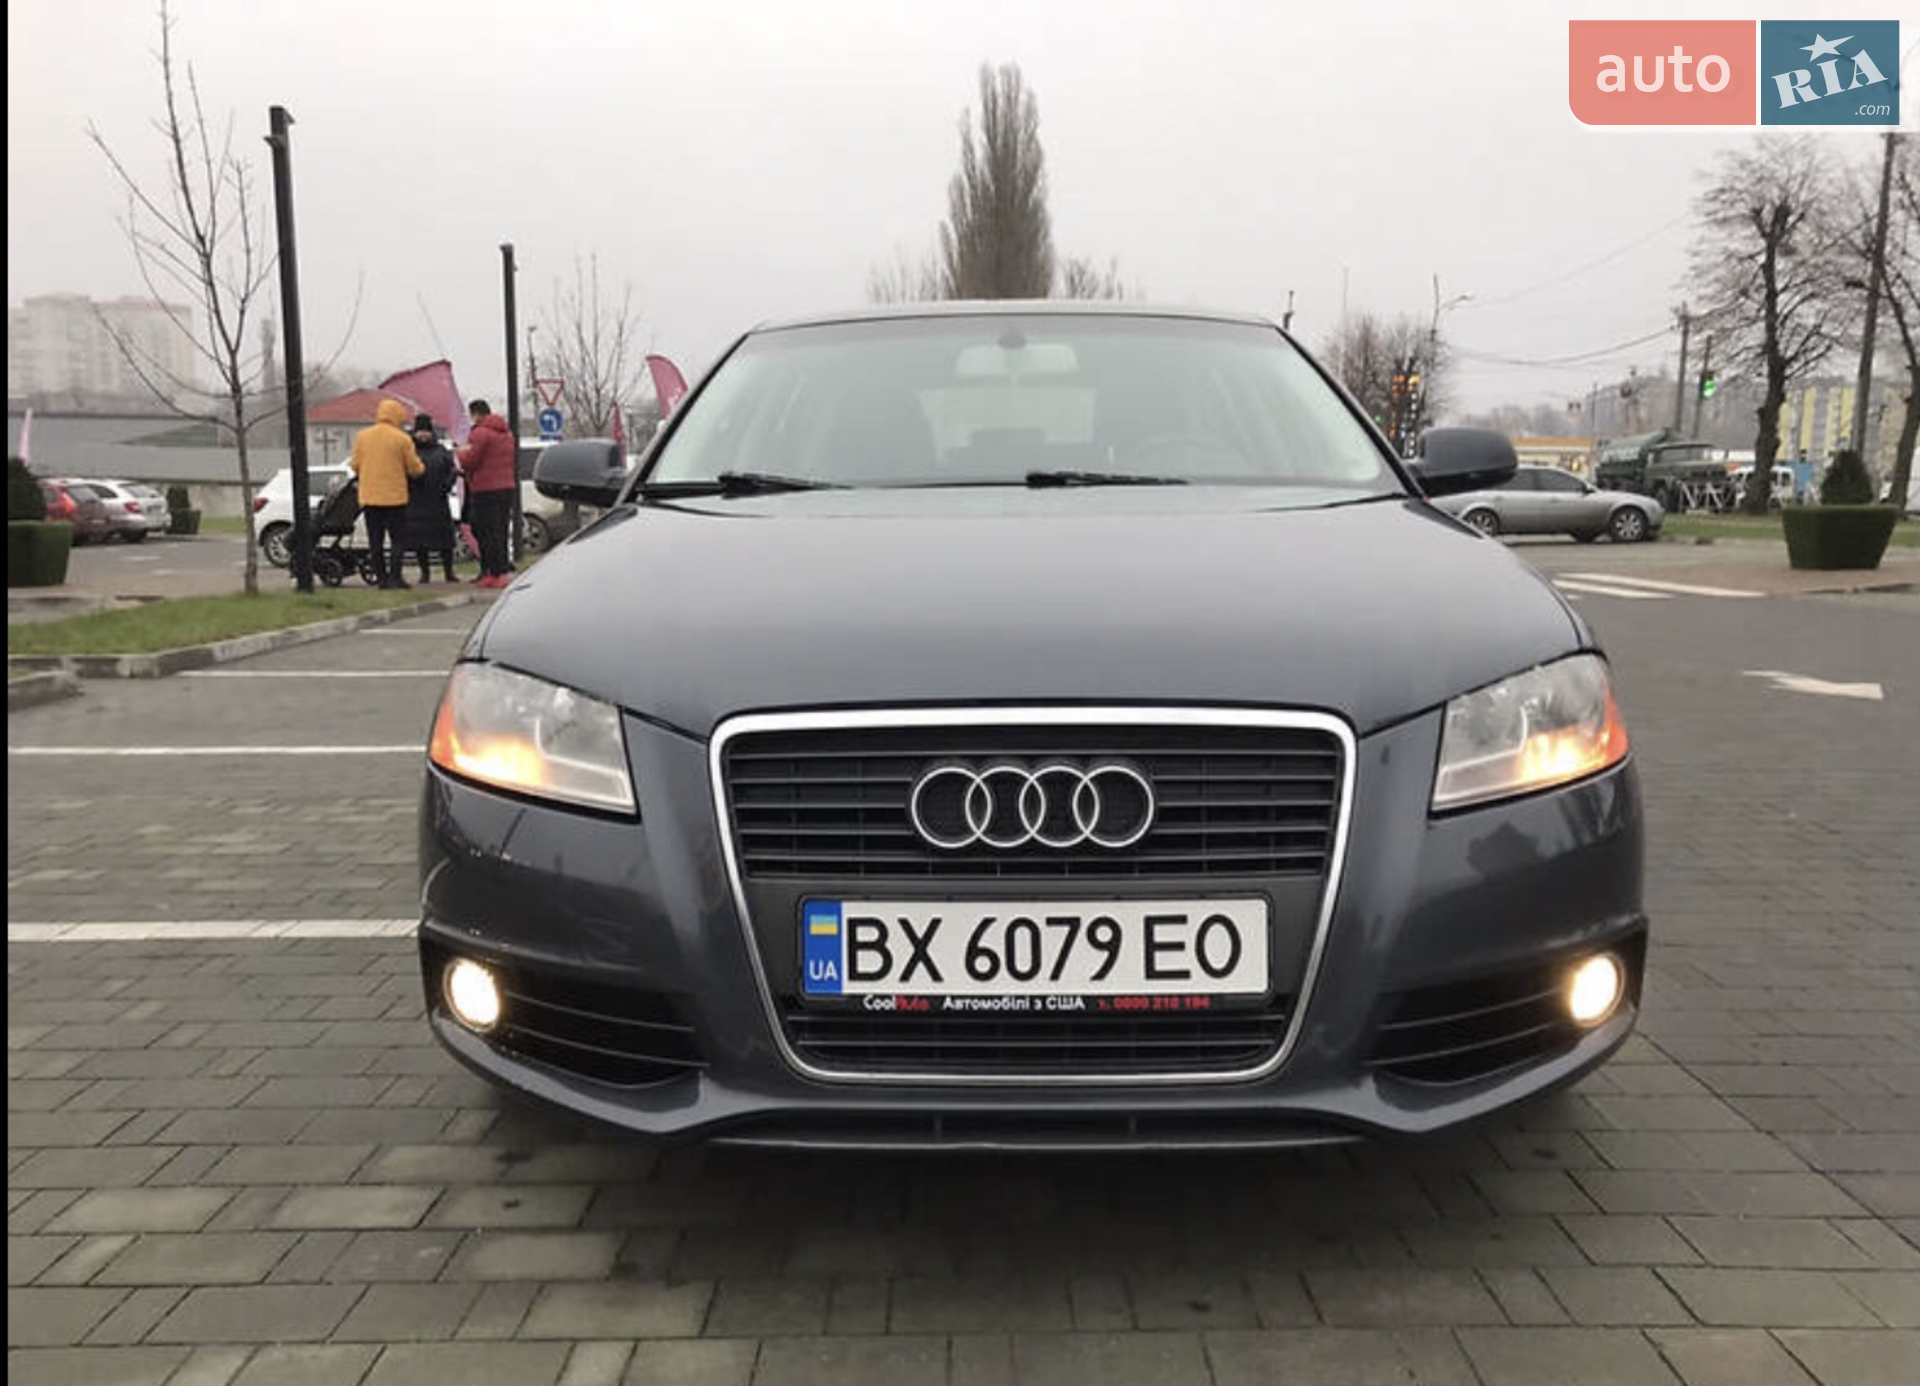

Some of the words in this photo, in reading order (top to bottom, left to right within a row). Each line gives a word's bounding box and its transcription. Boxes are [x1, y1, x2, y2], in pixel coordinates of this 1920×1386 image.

[846, 916, 945, 983] BX
[964, 916, 1123, 982] 6079
[1143, 913, 1243, 980] EO
[809, 958, 839, 982] UA
[942, 995, 1030, 1011] Автомобілі
[1045, 995, 1086, 1011] США
